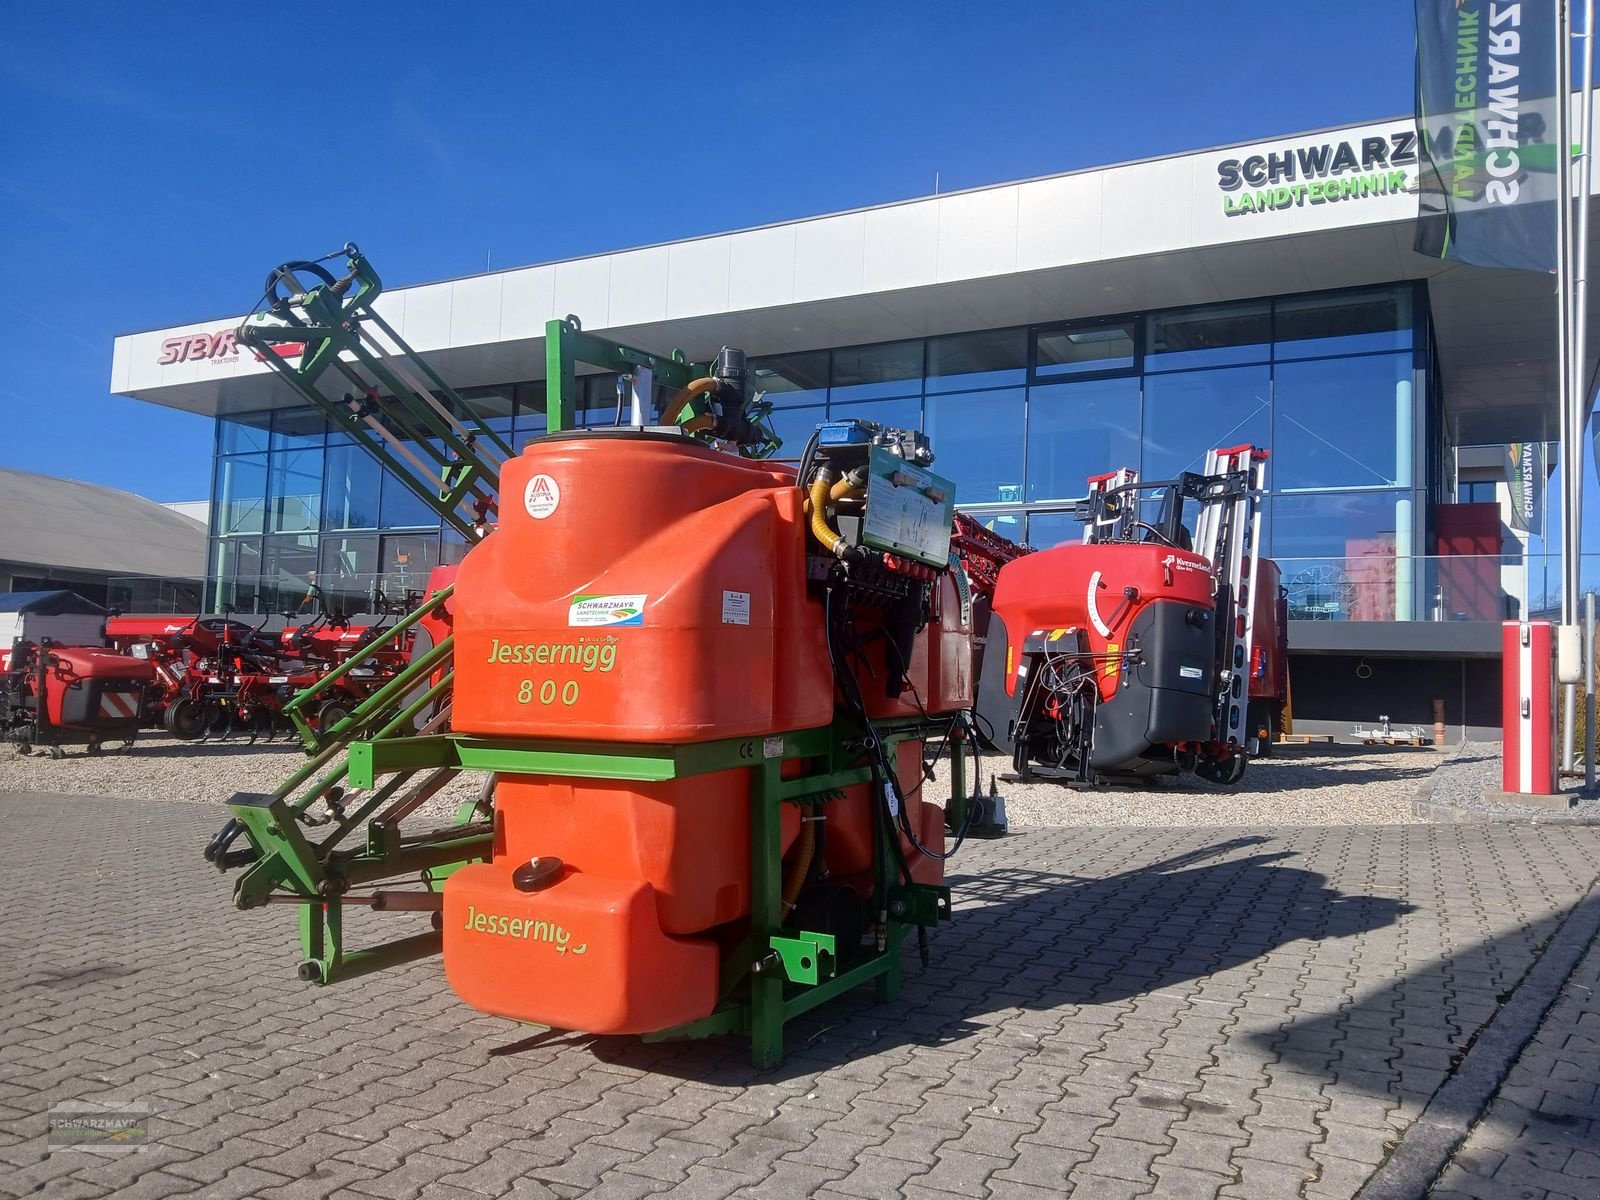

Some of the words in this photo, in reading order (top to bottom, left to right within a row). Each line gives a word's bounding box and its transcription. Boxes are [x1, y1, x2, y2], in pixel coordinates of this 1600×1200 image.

[1223, 170, 1407, 216] LANDTECHNIK
[157, 329, 239, 365] STEYR
[211, 356, 239, 366] TRAKTOREN
[577, 601, 634, 610] SCHWARZMAYR
[487, 638, 617, 672] Jessernigg
